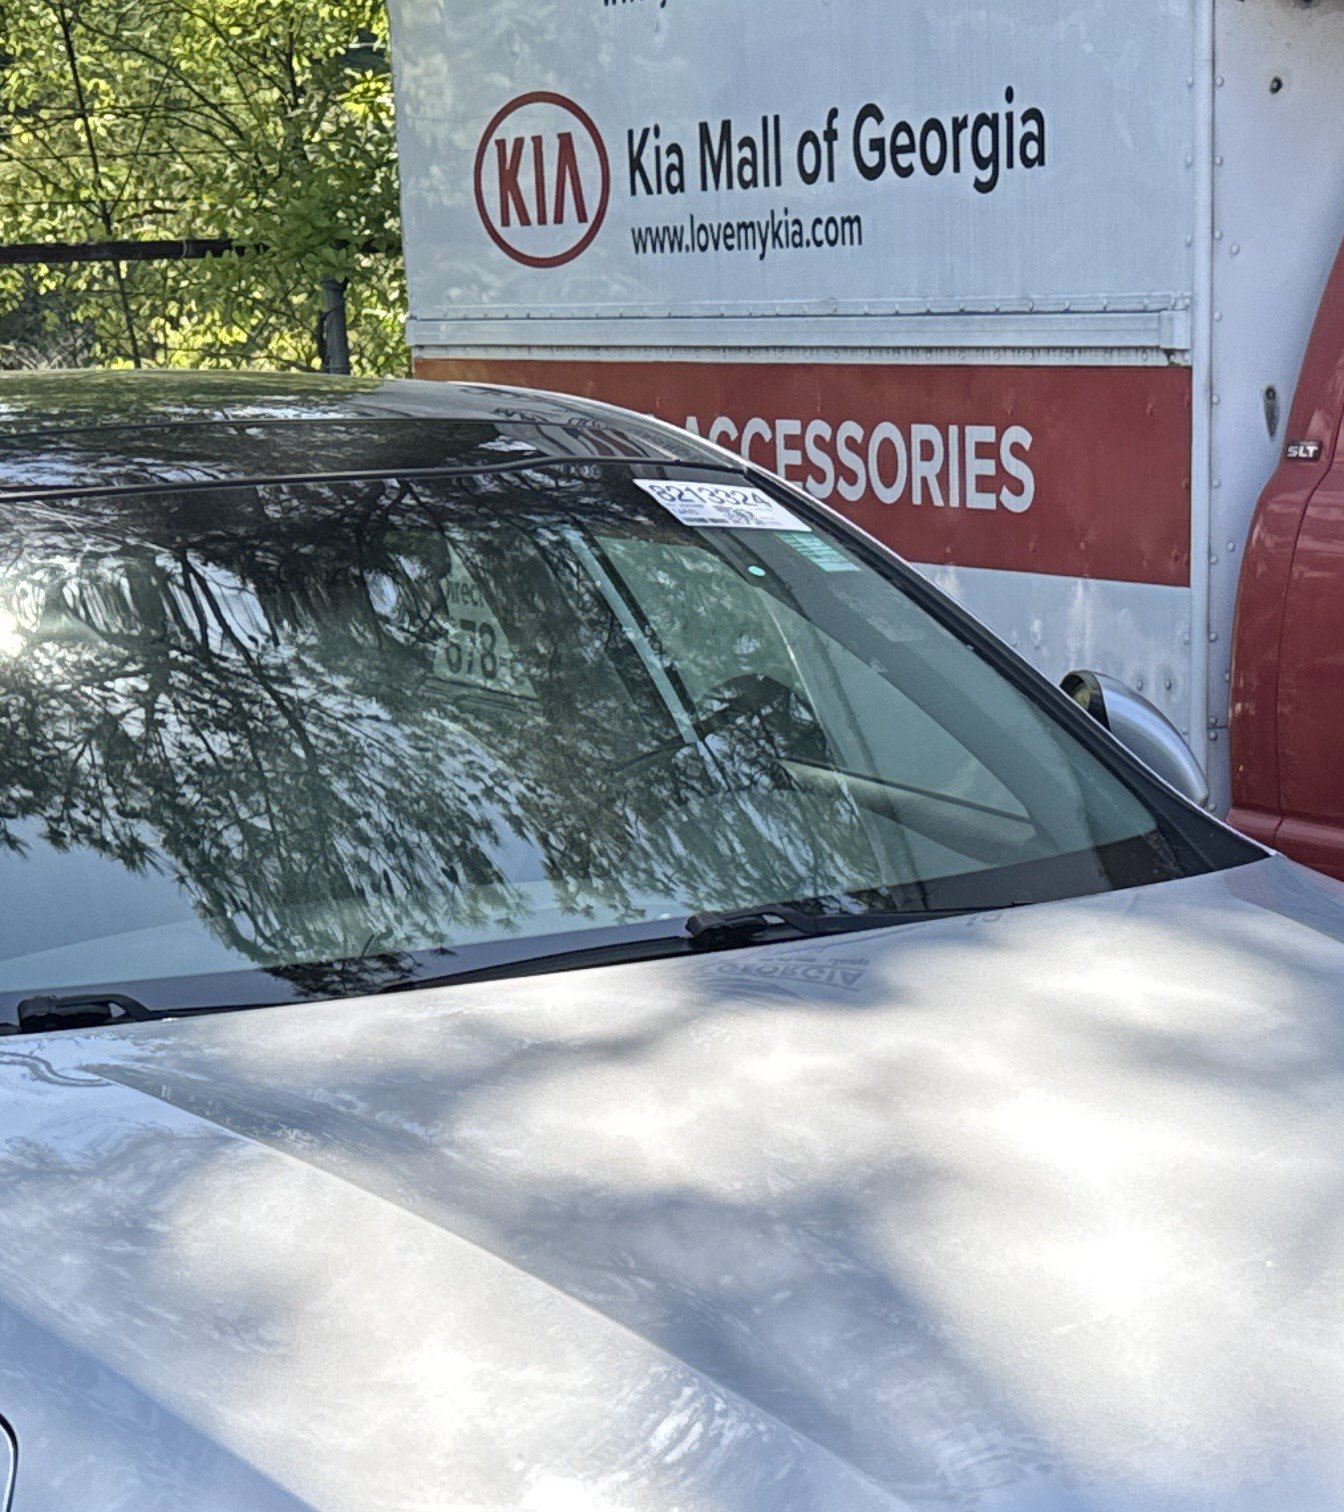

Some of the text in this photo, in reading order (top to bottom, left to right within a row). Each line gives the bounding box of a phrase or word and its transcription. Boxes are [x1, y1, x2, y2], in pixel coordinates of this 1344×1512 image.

[493, 131, 589, 228] KIA
[627, 84, 1046, 197] Kia Mall of Georgia
[630, 206, 863, 262] www.lovemykia.com
[684, 415, 1036, 514] CESSORIES
[1285, 445, 1319, 458] SLT
